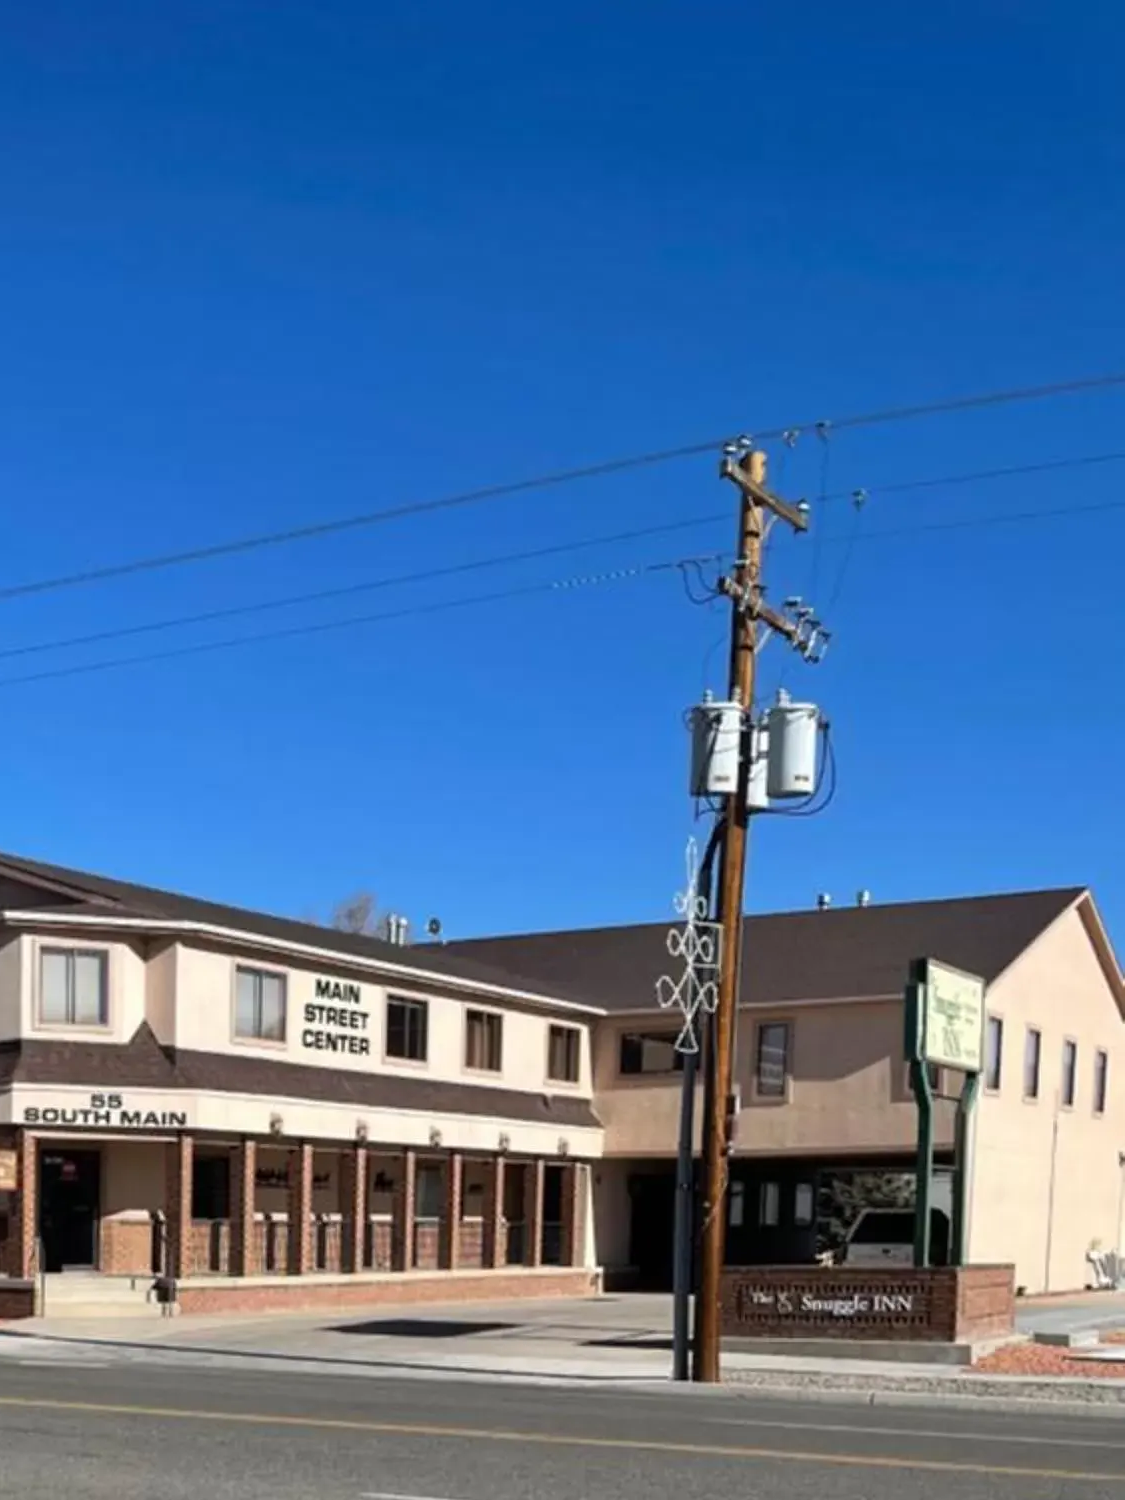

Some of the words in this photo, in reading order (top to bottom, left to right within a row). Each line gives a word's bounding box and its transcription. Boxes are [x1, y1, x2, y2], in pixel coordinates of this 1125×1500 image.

[315, 979, 361, 1004] MAIN
[304, 1003, 370, 1030] STREET
[302, 1029, 370, 1056] CENTER
[90, 1093, 123, 1109] 55
[24, 1107, 111, 1124] SOUTH
[120, 1111, 187, 1126] MAIN
[801, 1294, 868, 1316] Snuggle
[873, 1294, 913, 1312] INN
